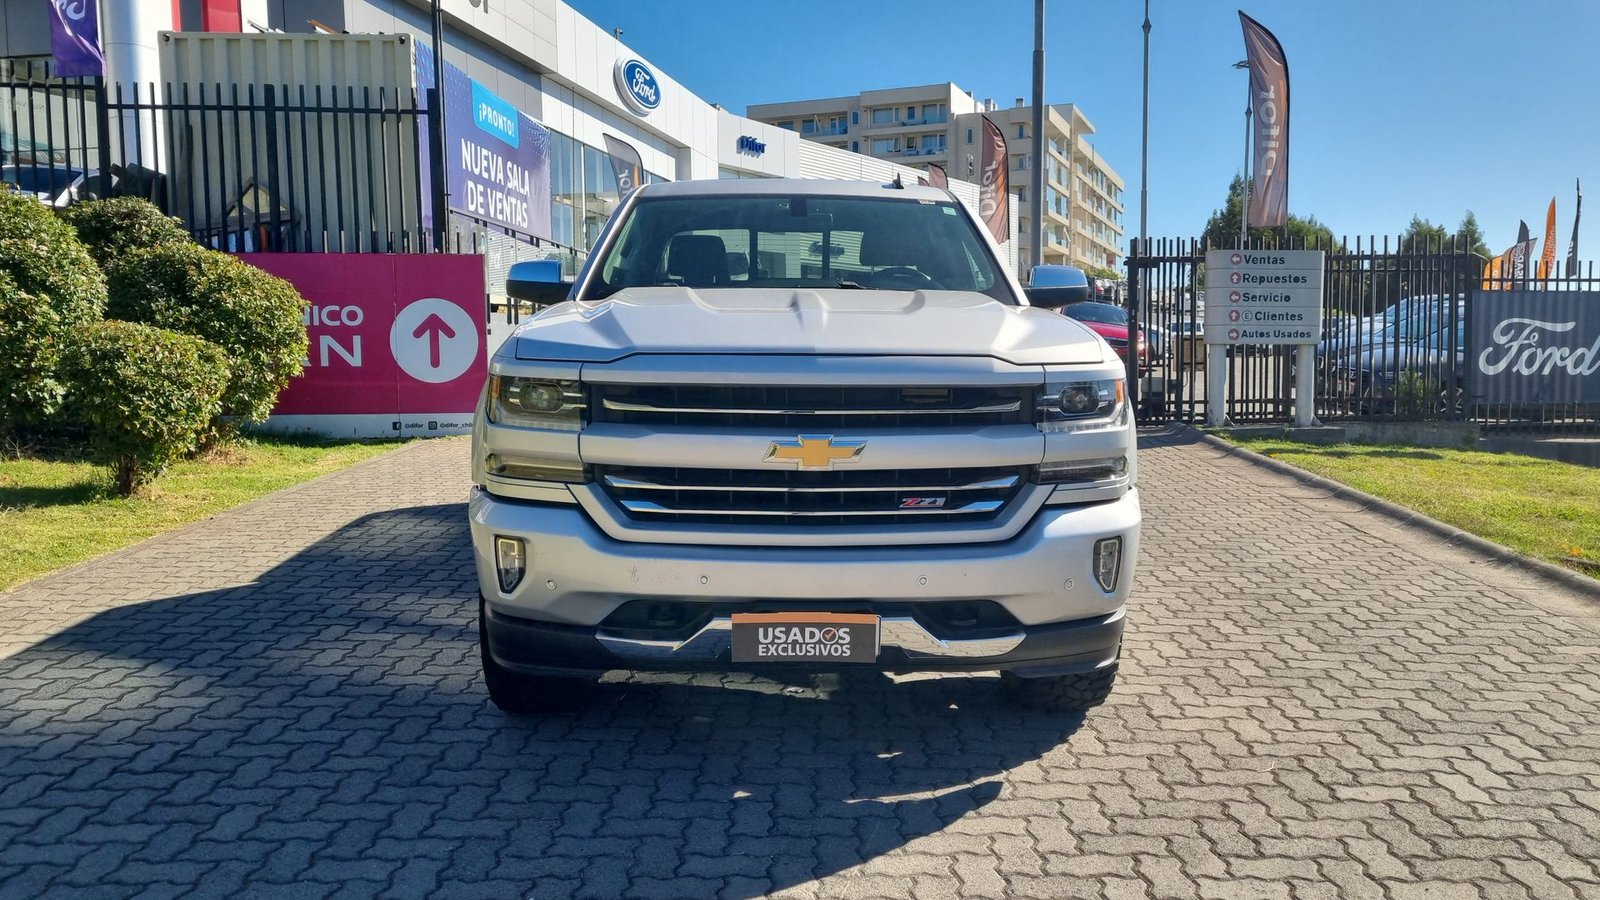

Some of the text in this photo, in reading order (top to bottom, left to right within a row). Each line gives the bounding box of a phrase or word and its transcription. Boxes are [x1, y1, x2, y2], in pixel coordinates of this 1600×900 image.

[633, 67, 656, 102] Ford
[479, 102, 515, 137] ¡PRONTO!
[461, 137, 531, 197] NUEVA SALA
[467, 180, 528, 229] DE VENTAS
[1244, 254, 1286, 265] Ventas
[1242, 273, 1308, 286] Repuestos
[1242, 292, 1291, 303] Servicio
[1254, 311, 1304, 321] Clientes
[1241, 329, 1312, 339] Autos Usados
[1479, 317, 1600, 376] Ford
[900, 497, 946, 508] Z71
[758, 627, 851, 645] USADOS
[758, 644, 851, 657] EXCLUSIVOS
